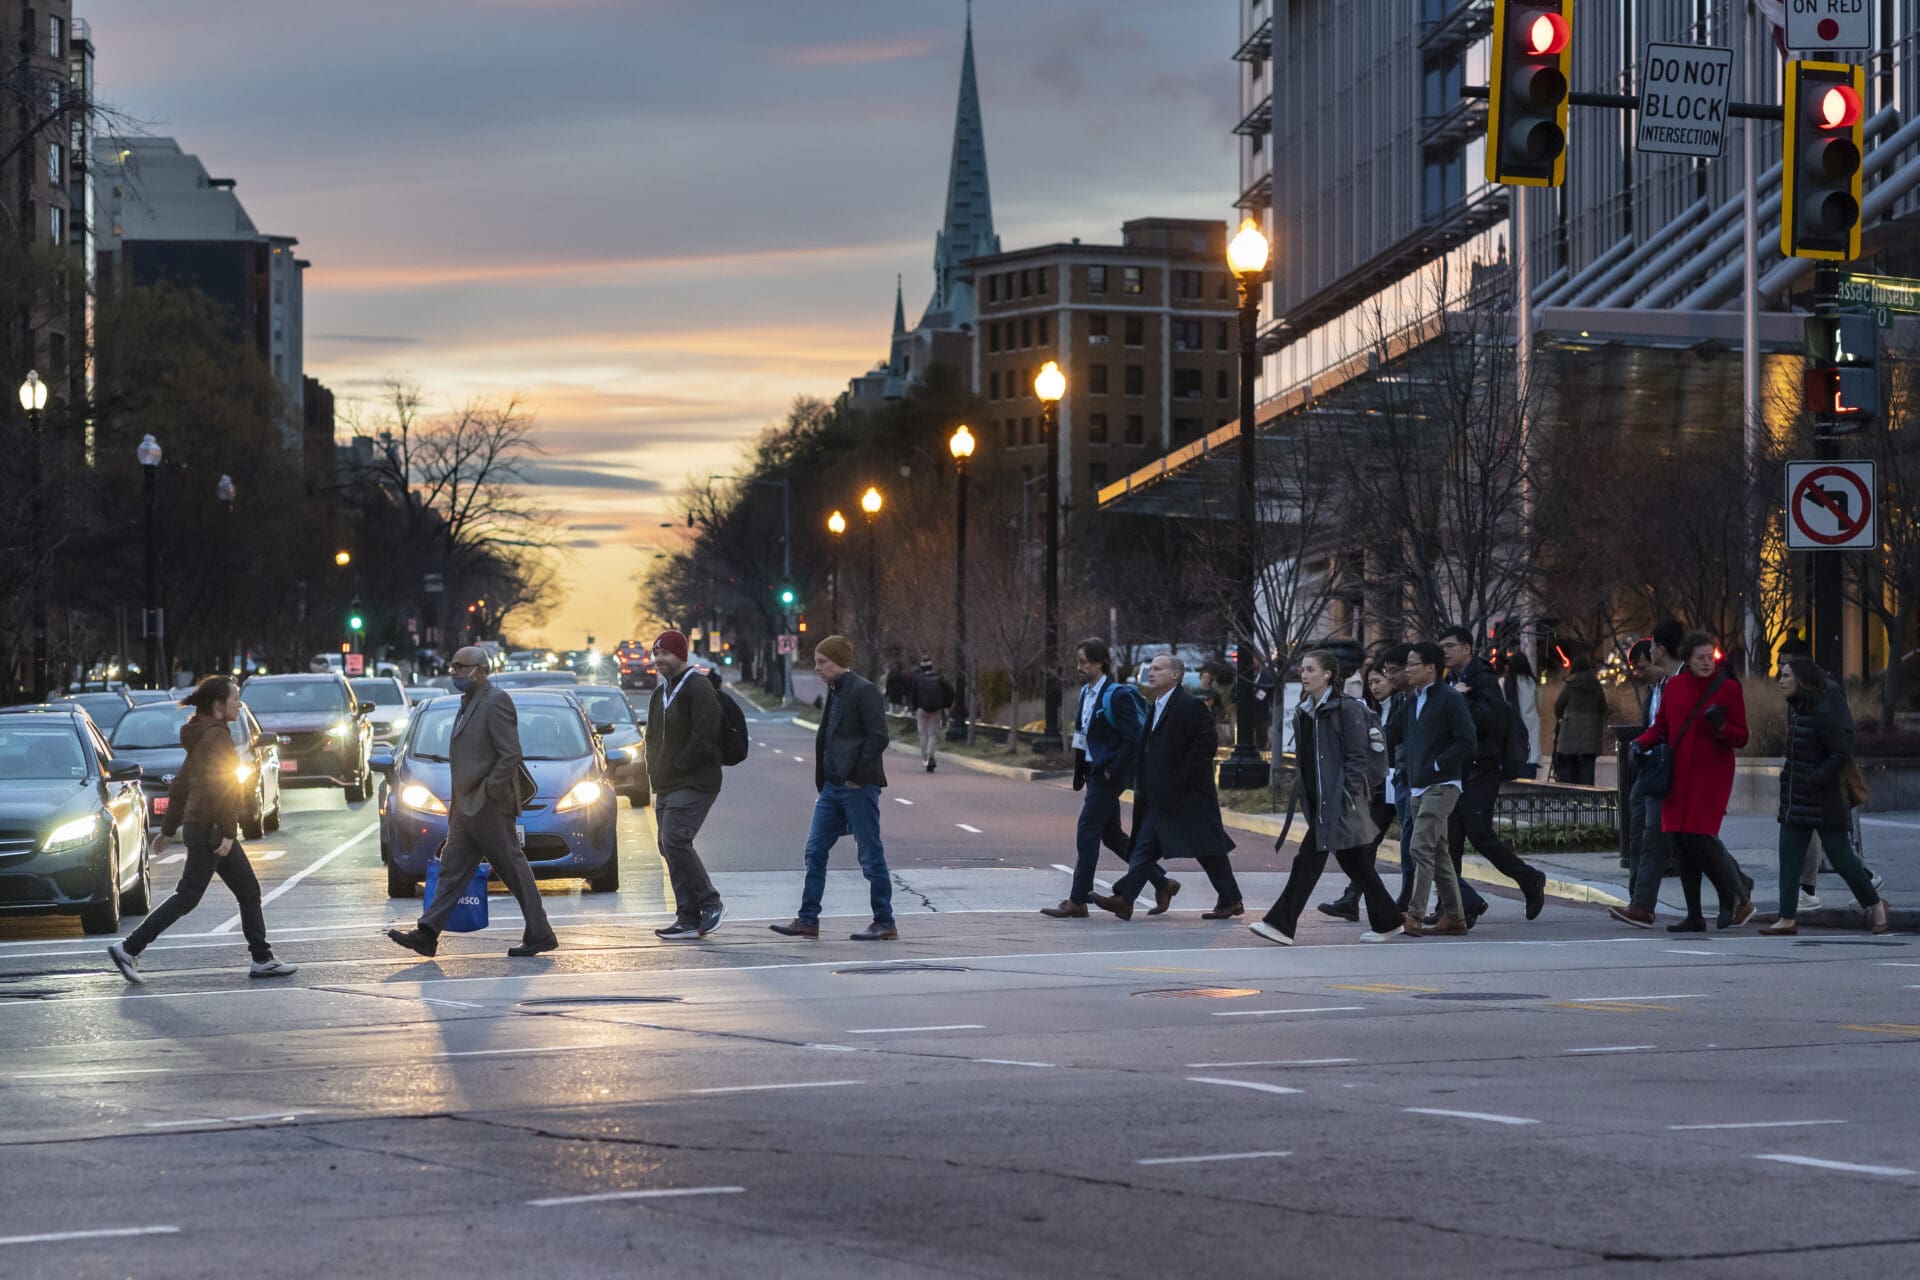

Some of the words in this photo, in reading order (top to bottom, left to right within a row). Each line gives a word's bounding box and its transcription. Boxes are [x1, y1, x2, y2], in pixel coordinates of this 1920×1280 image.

[1793, 0, 1817, 13] ON
[1827, 0, 1863, 13] RED
[1650, 58, 1680, 83] DO
[1683, 60, 1729, 86] NOT
[1645, 93, 1722, 122] BLOCK
[1641, 125, 1720, 146] INTERSECTION
[1838, 280, 1915, 306] assachusetts
[457, 896, 480, 905] NSCO
